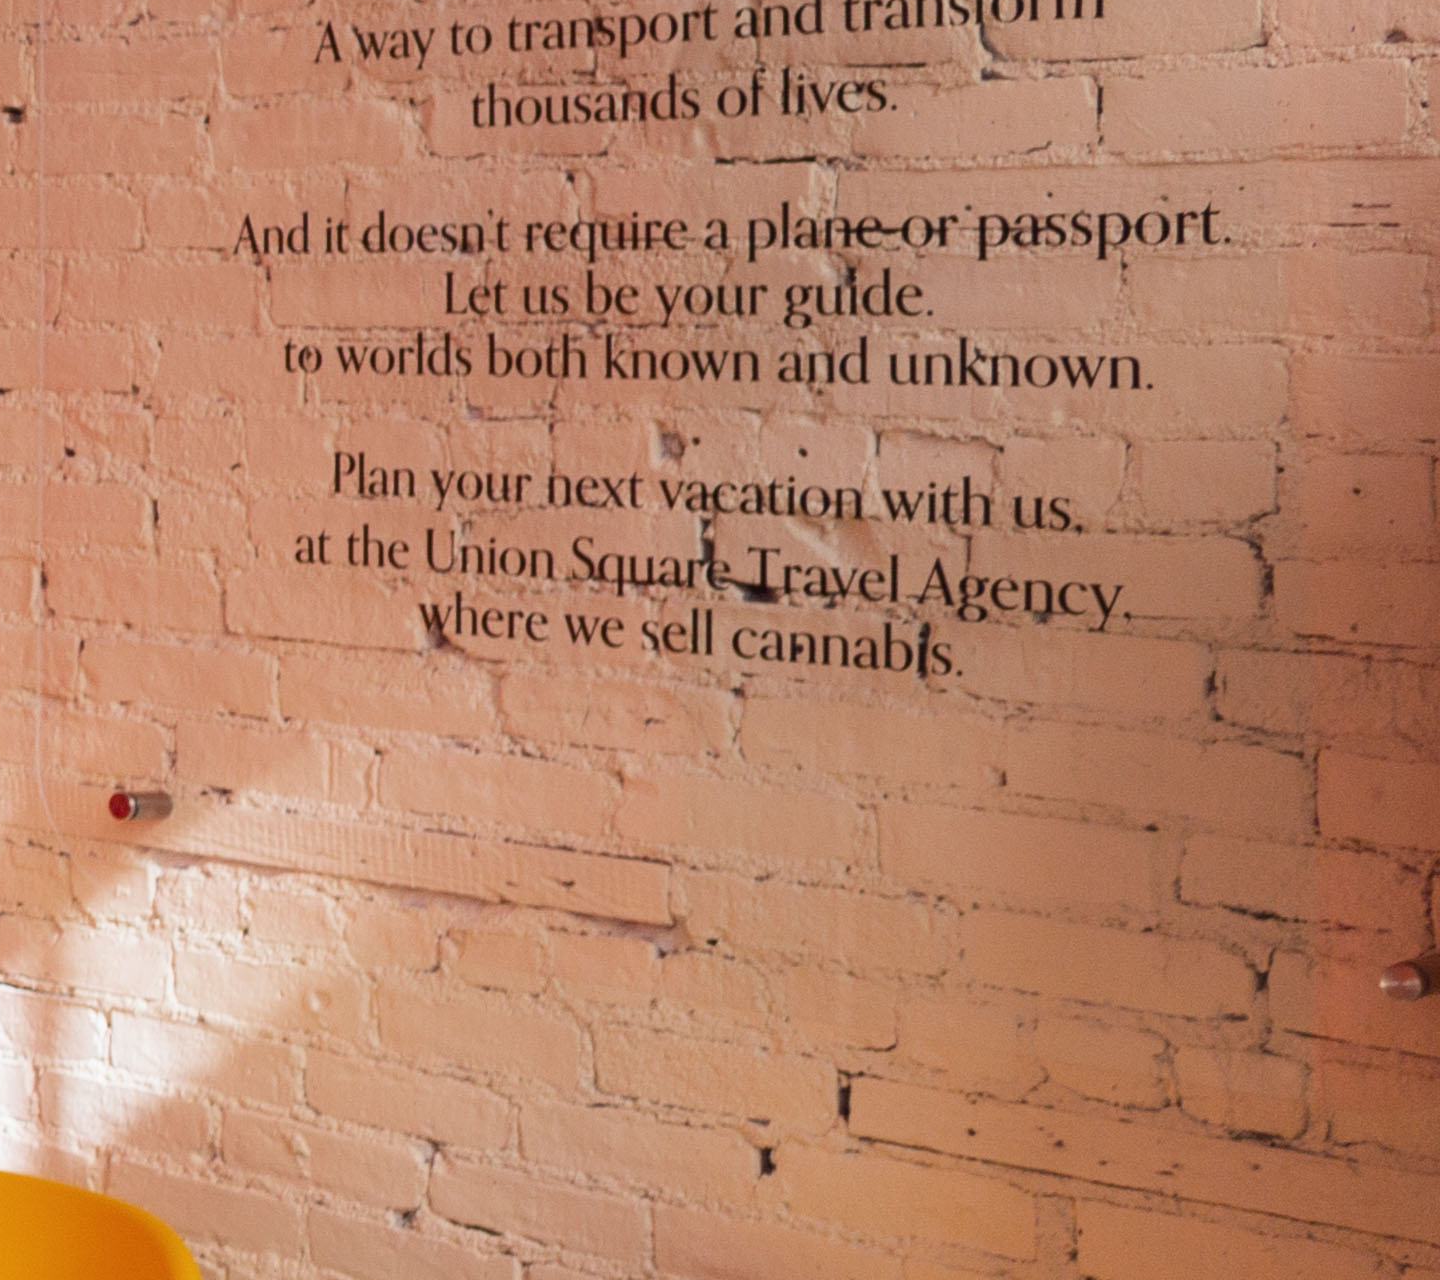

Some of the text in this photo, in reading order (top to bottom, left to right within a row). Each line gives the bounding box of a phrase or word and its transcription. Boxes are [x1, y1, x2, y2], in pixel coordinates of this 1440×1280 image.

[314, 21, 342, 63] A
[356, 27, 435, 69] way
[451, 21, 492, 56] to
[508, 3, 717, 58] transport
[472, 67, 897, 128] thousands of lives.
[233, 201, 1232, 264] And it doesn't require a plane or passport.
[445, 267, 934, 329] Let us be your guide.
[284, 332, 1154, 390] to worlds both known and unknown.
[333, 451, 415, 497] Plan
[431, 469, 532, 510] your
[548, 471, 644, 509] next
[659, 477, 863, 519] vacation
[882, 475, 991, 526] with
[295, 524, 1131, 632] at the Union Square Travel Agency,
[418, 591, 964, 677] where we sell cannabis.
